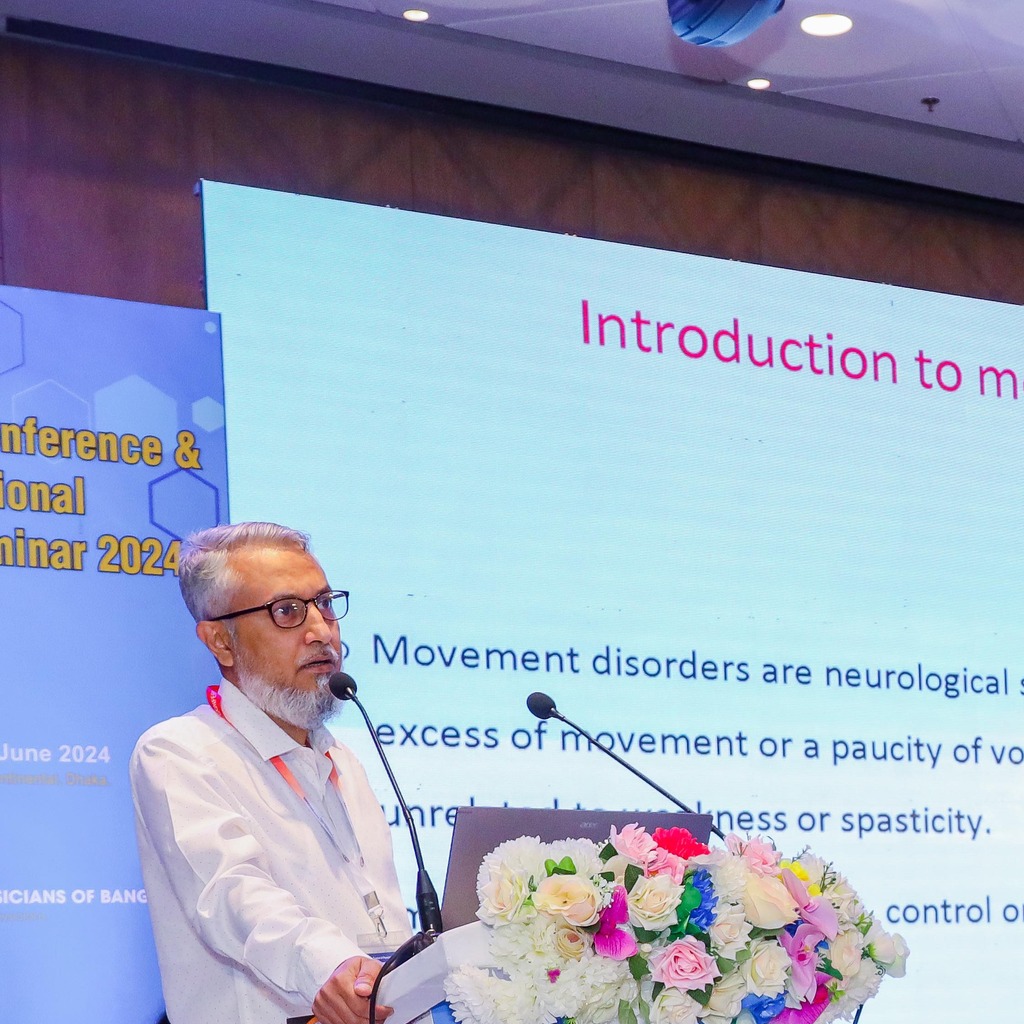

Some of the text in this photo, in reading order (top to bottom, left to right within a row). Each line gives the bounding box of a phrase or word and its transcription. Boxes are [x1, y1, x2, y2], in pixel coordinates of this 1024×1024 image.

[581, 299, 898, 384] Introduction
[915, 350, 962, 392] to
[174, 430, 202, 470] &
[97, 535, 181, 577] 2024
[373, 634, 580, 674] Movement
[593, 646, 750, 682] disorders
[762, 663, 812, 685] are
[826, 663, 1008, 698] neurological
[59, 745, 111, 763] 2024
[376, 721, 498, 749] excess
[512, 720, 547, 750] of
[561, 729, 748, 757] movement
[760, 737, 793, 758] or
[804, 739, 819, 759] a
[833, 736, 942, 768] paucity
[953, 737, 983, 764] of
[798, 811, 830, 832] or
[841, 808, 991, 840] spasticity.
[71, 888, 94, 904] OF
[886, 896, 991, 924] control
